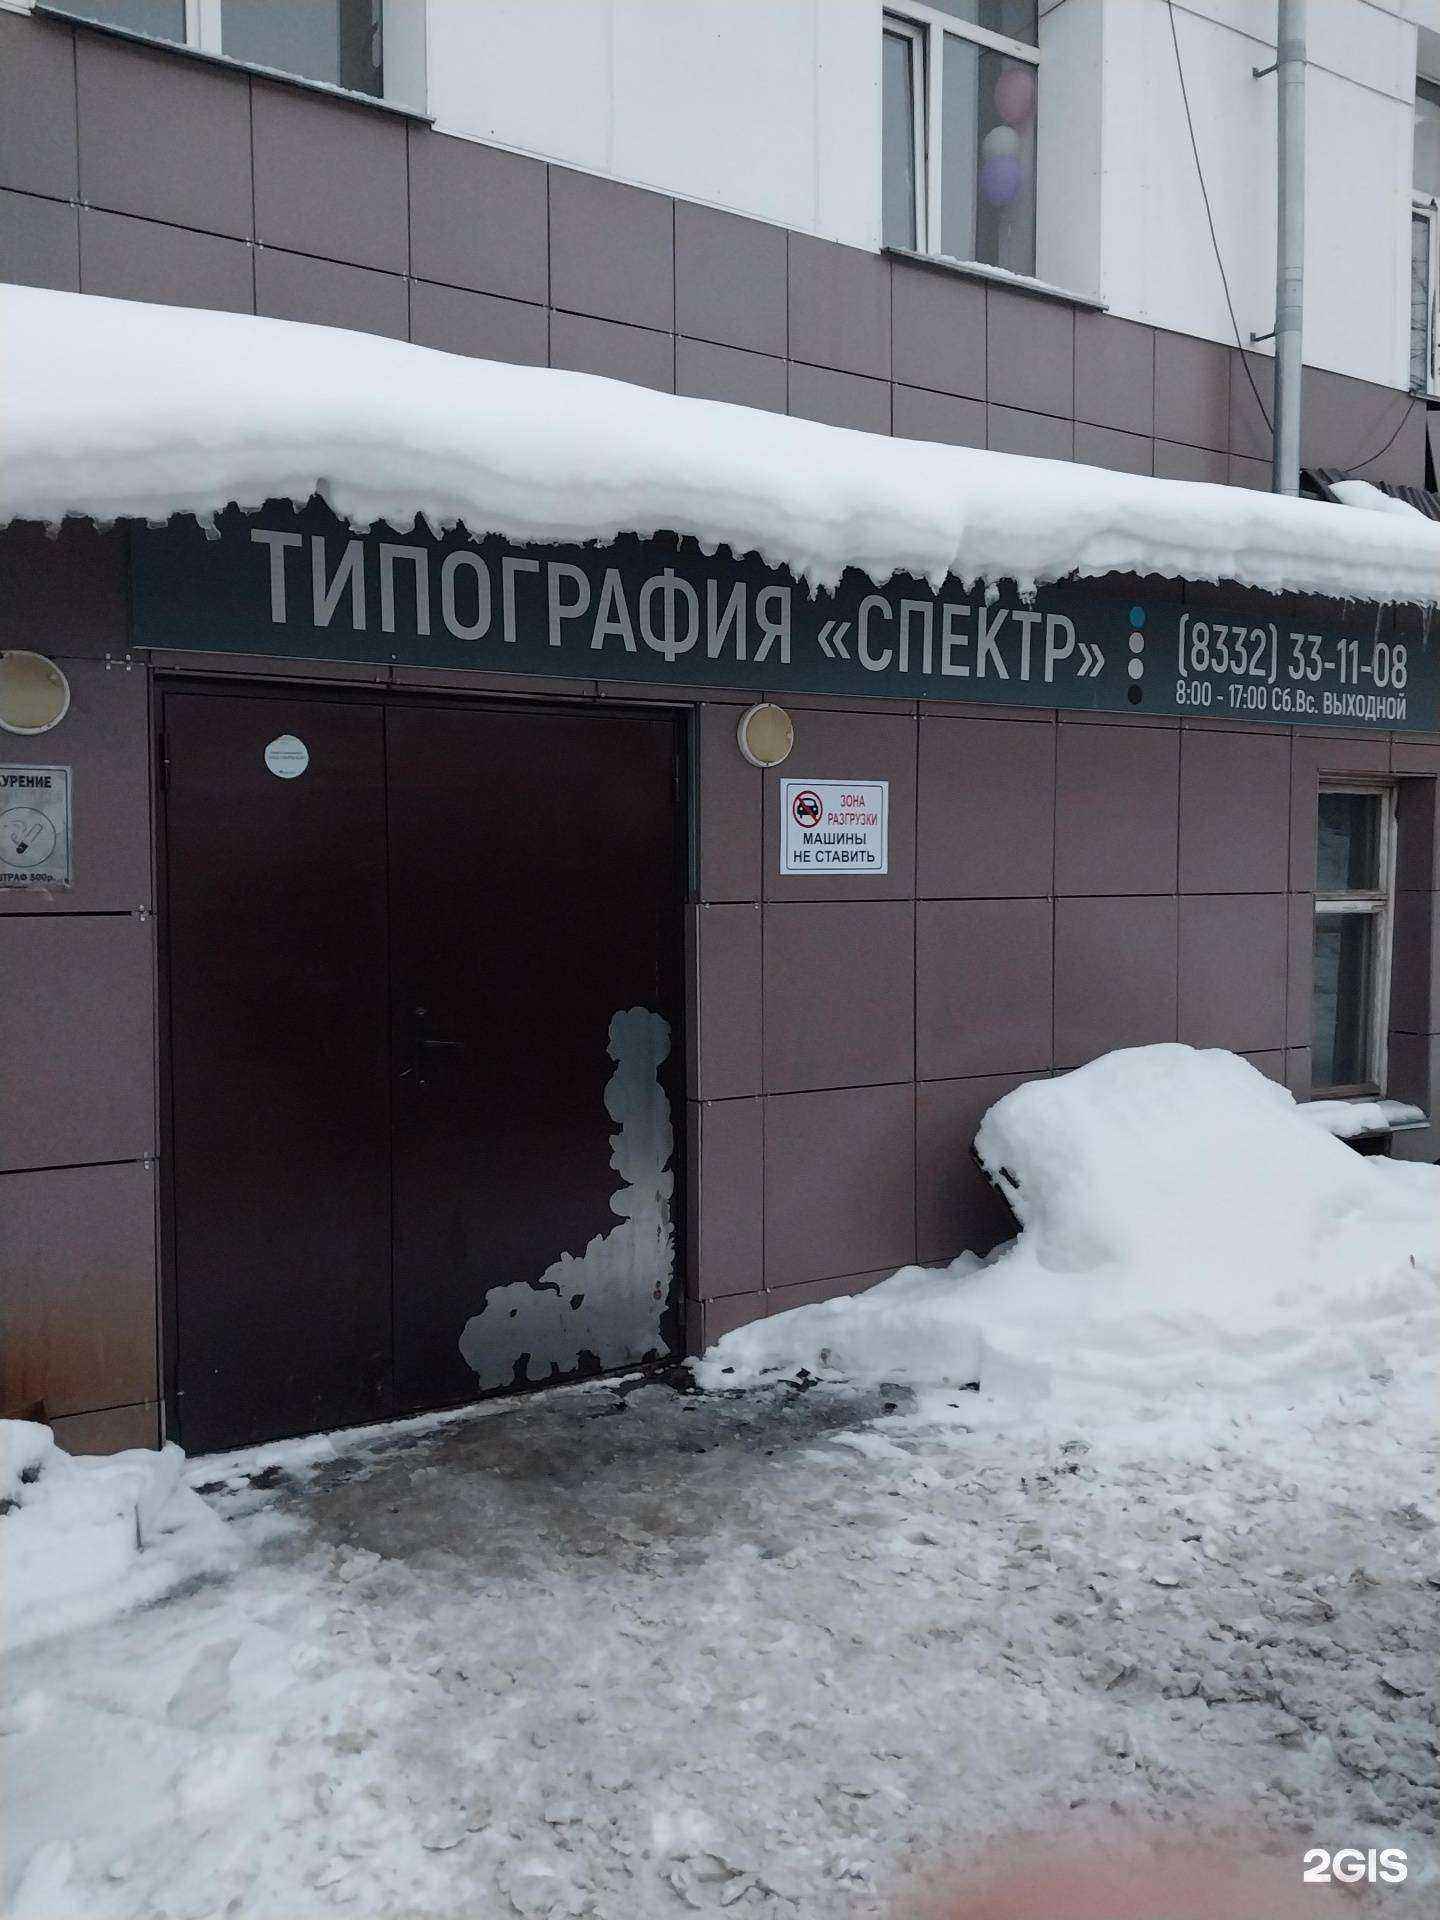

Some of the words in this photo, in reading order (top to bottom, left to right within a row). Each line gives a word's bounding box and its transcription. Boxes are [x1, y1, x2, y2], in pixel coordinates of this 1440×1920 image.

[250, 528, 792, 664] ТИПОГРАФИЯ
[817, 595, 1105, 683] «СПЕКТР»
[1178, 613, 1278, 684] (8332)
[1288, 632, 1408, 689] 33-11-08
[1175, 679, 1212, 707] 8:00
[1228, 684, 1267, 710] 17:00
[1323, 692, 1407, 721] ВЫХОДНОЙ
[0, 775, 52, 788] УРЕНИЕ
[840, 794, 865, 807] ЗОНА
[827, 812, 878, 826] РАЗГРУЗКИ
[803, 832, 867, 845] МАШИНЫ
[793, 850, 811, 863] НЕ
[815, 851, 875, 863] СТАВИТЬ
